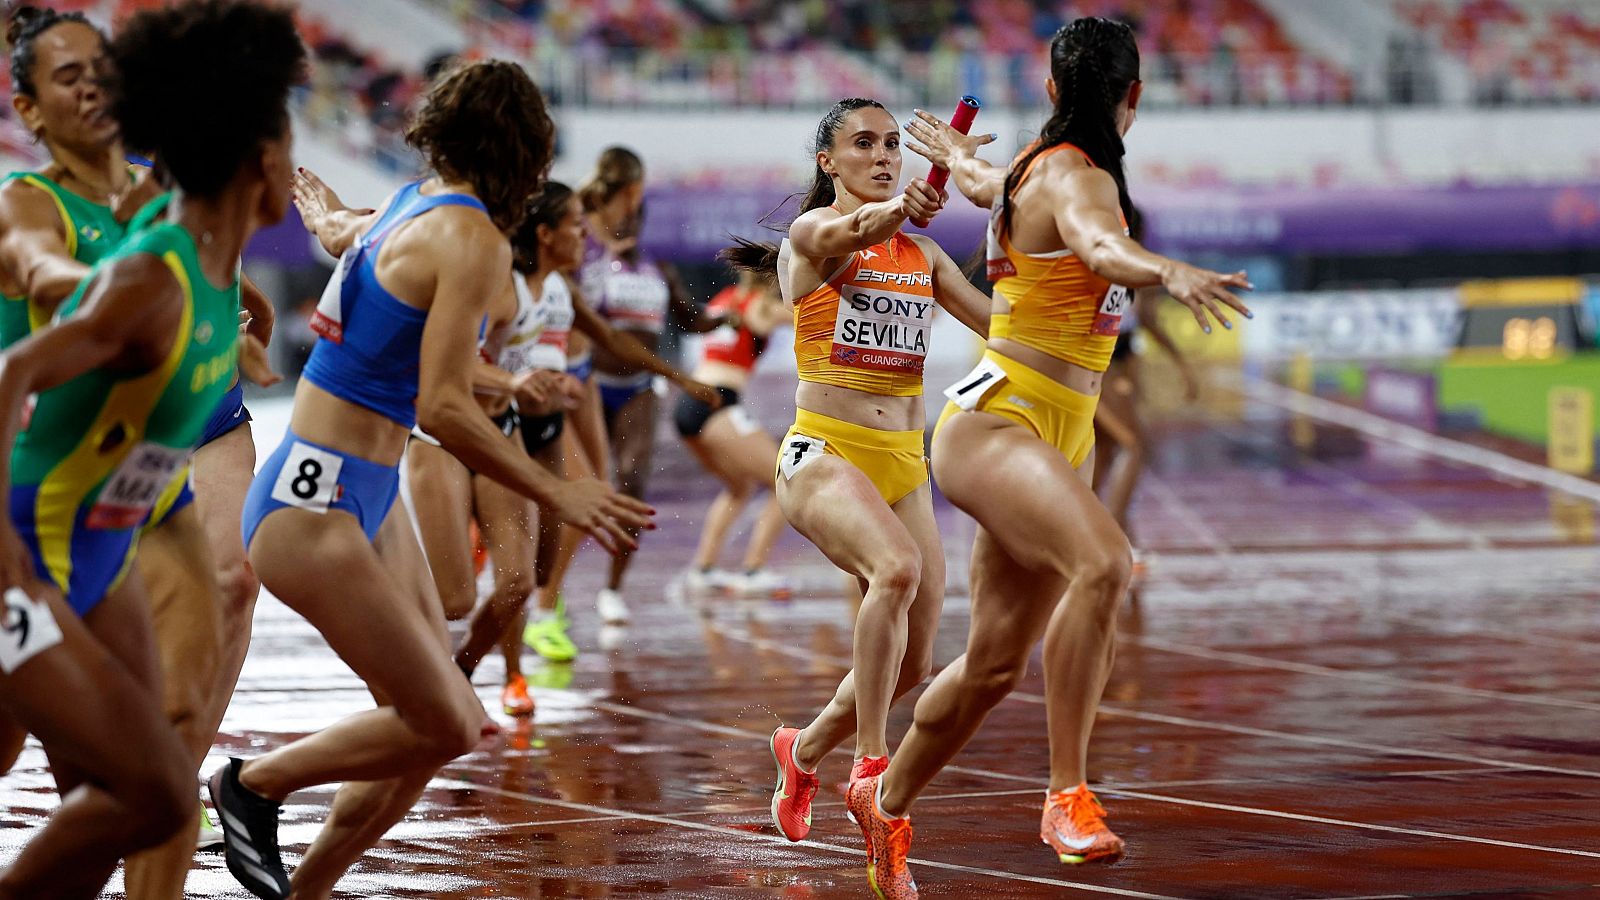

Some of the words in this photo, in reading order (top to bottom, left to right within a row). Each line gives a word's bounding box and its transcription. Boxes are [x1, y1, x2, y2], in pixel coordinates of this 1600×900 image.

[854, 268, 932, 287] ESPAÑA
[851, 293, 930, 319] SONY
[841, 318, 926, 353] SEVILLA
[957, 371, 993, 396] 1
[790, 441, 811, 466] 7
[291, 458, 322, 499] 8
[4, 604, 29, 650] 9
